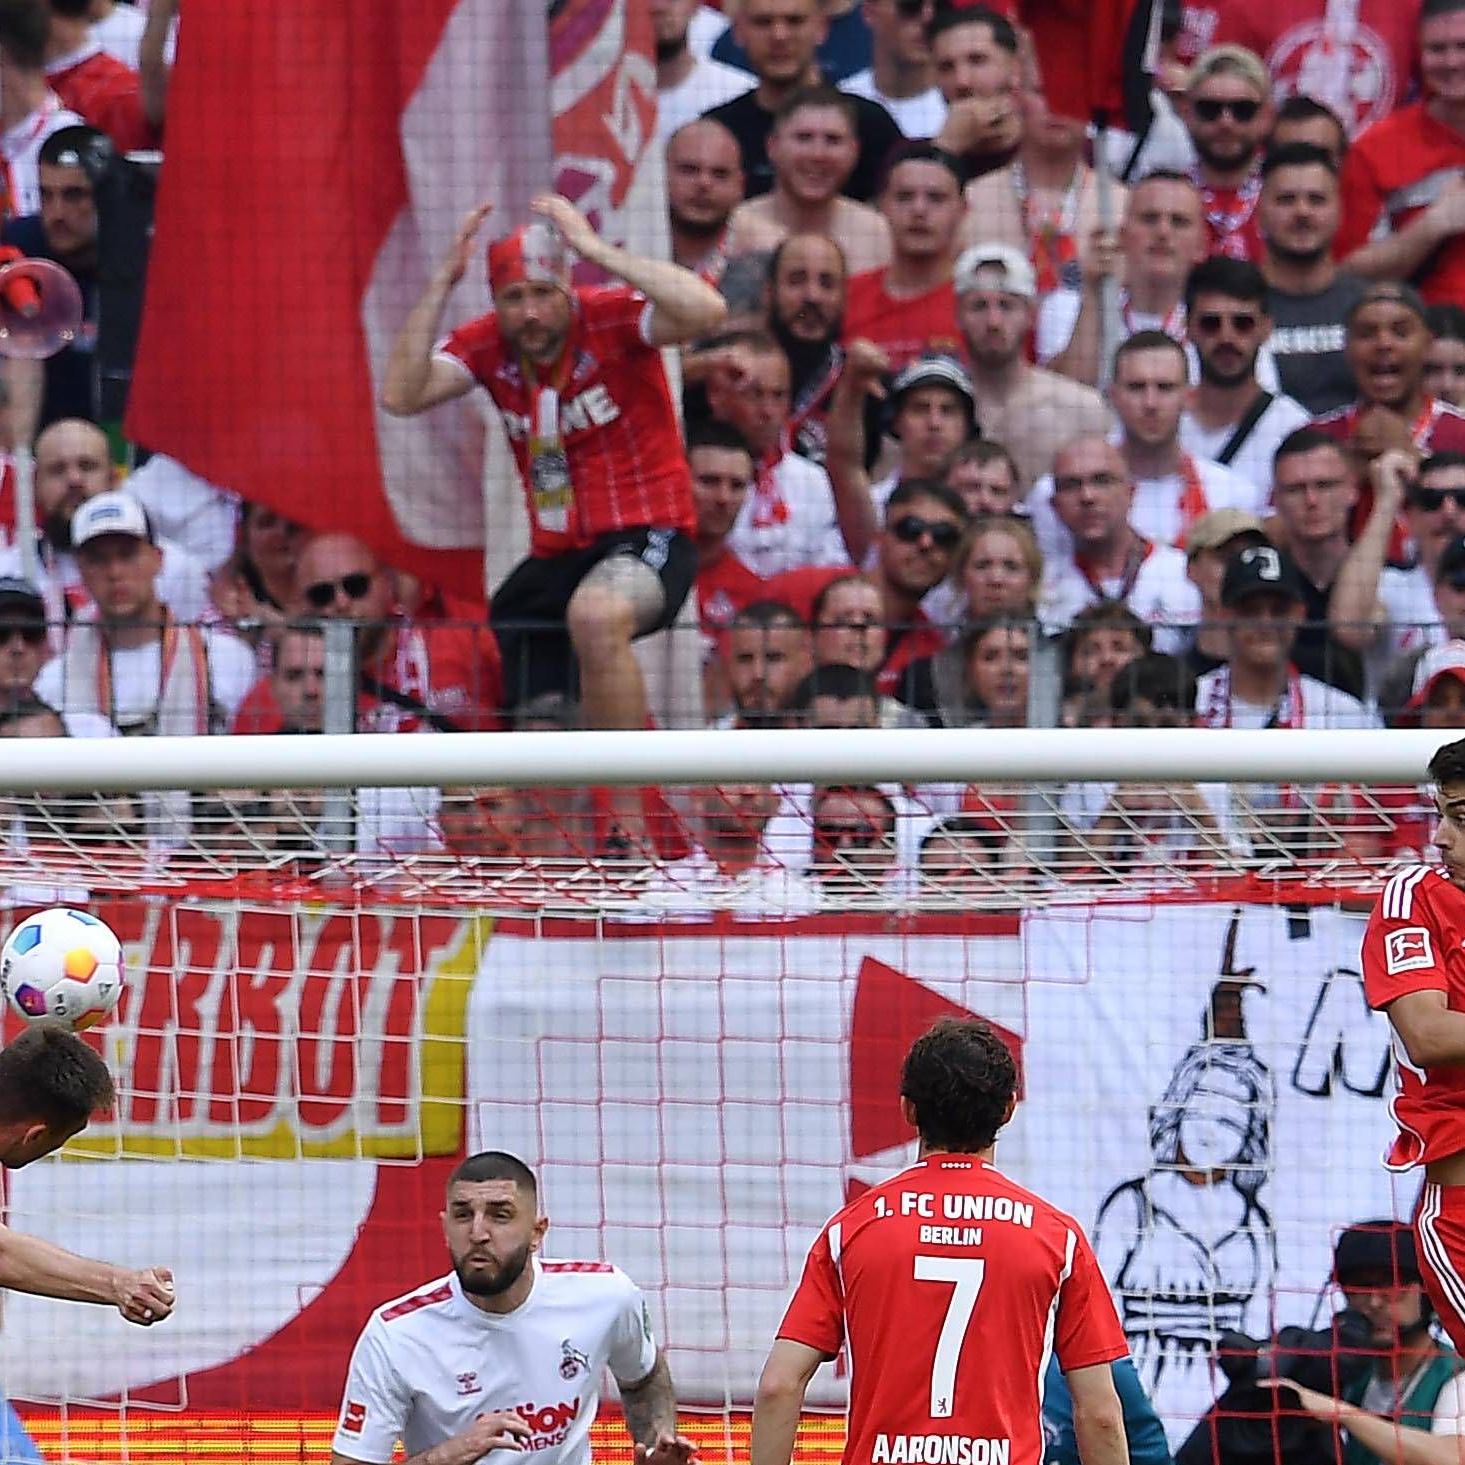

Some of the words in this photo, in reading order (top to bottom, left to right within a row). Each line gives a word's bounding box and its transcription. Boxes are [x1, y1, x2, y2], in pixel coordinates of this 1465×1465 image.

[874, 1196, 894, 1218] 1.
[901, 1192, 935, 1218] FC
[943, 1194, 1034, 1228] UNION
[920, 1225, 982, 1246] BERLIN
[913, 1255, 985, 1418] 7
